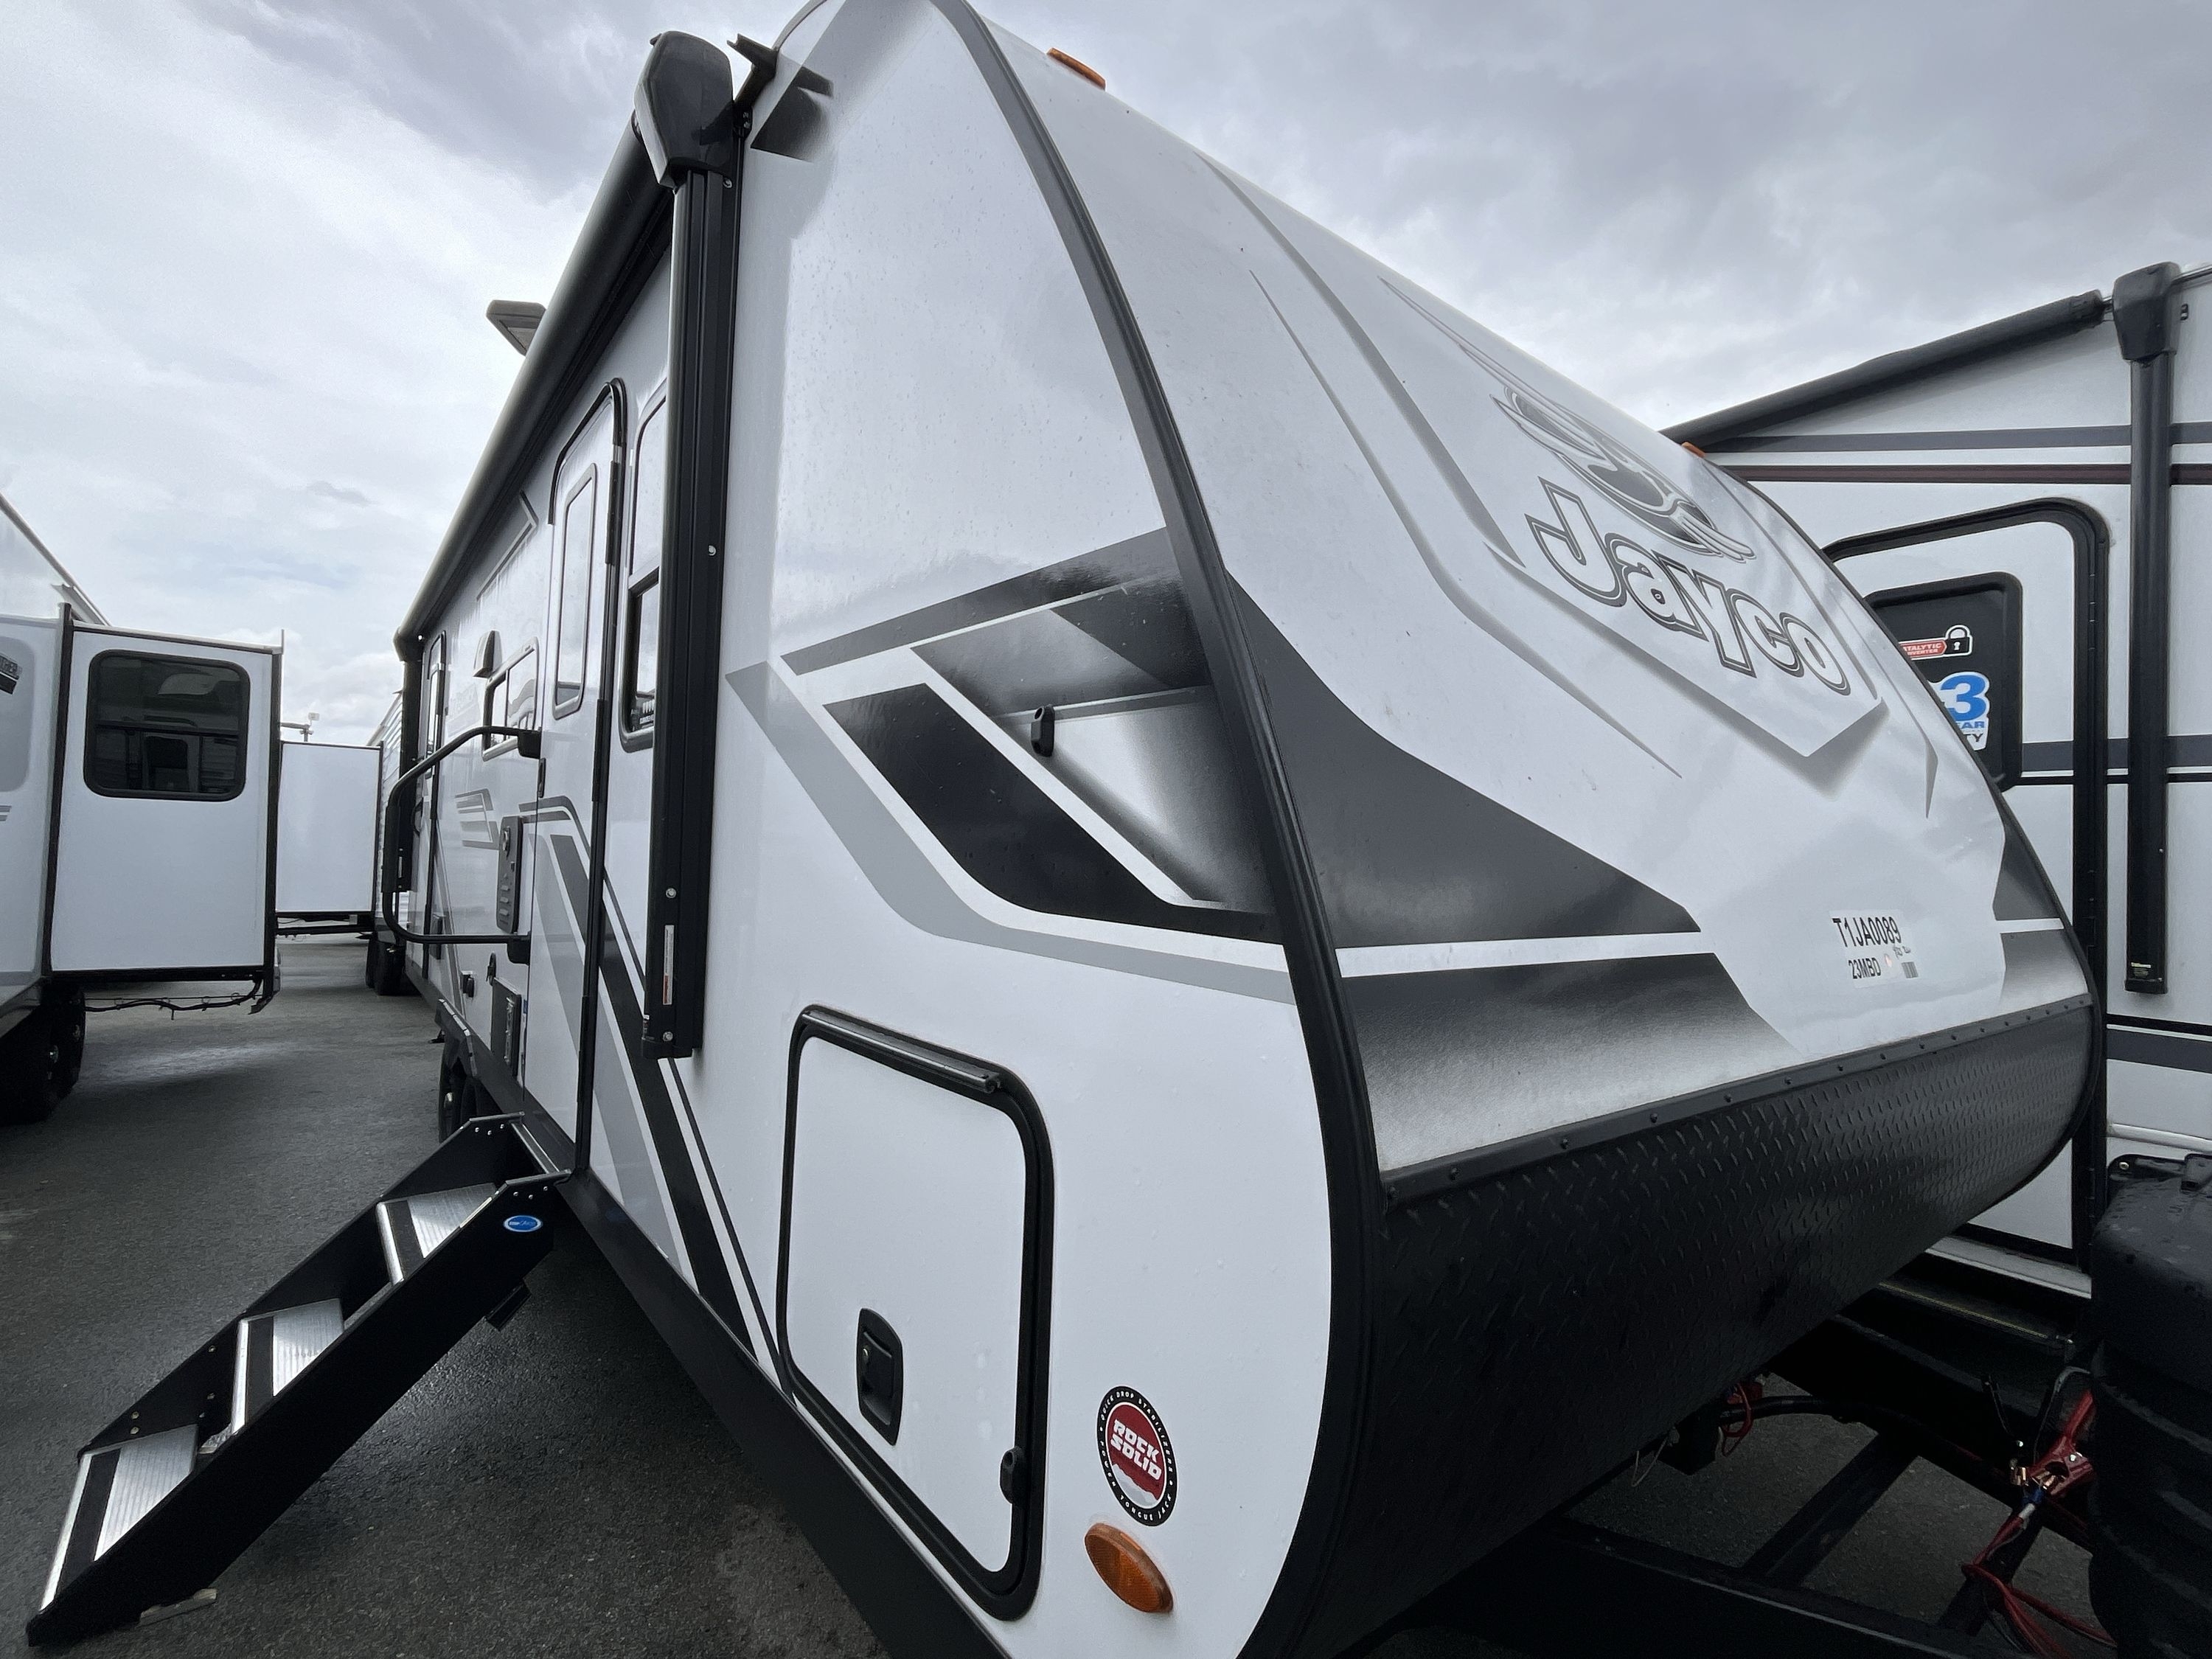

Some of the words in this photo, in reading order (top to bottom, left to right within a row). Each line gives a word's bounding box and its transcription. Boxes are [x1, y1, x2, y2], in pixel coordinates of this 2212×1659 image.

[1524, 476, 1851, 695] Jayco
[1958, 720, 1985, 728] AR
[1832, 917, 1902, 947] T1JA0089
[1100, 1395, 1114, 1421] QUICK
[1116, 1391, 1134, 1399] DROP
[1113, 1419, 1160, 1463] ROCK
[1110, 1433, 1162, 1481] SOLID
[1158, 1493, 1172, 1520] JACK
